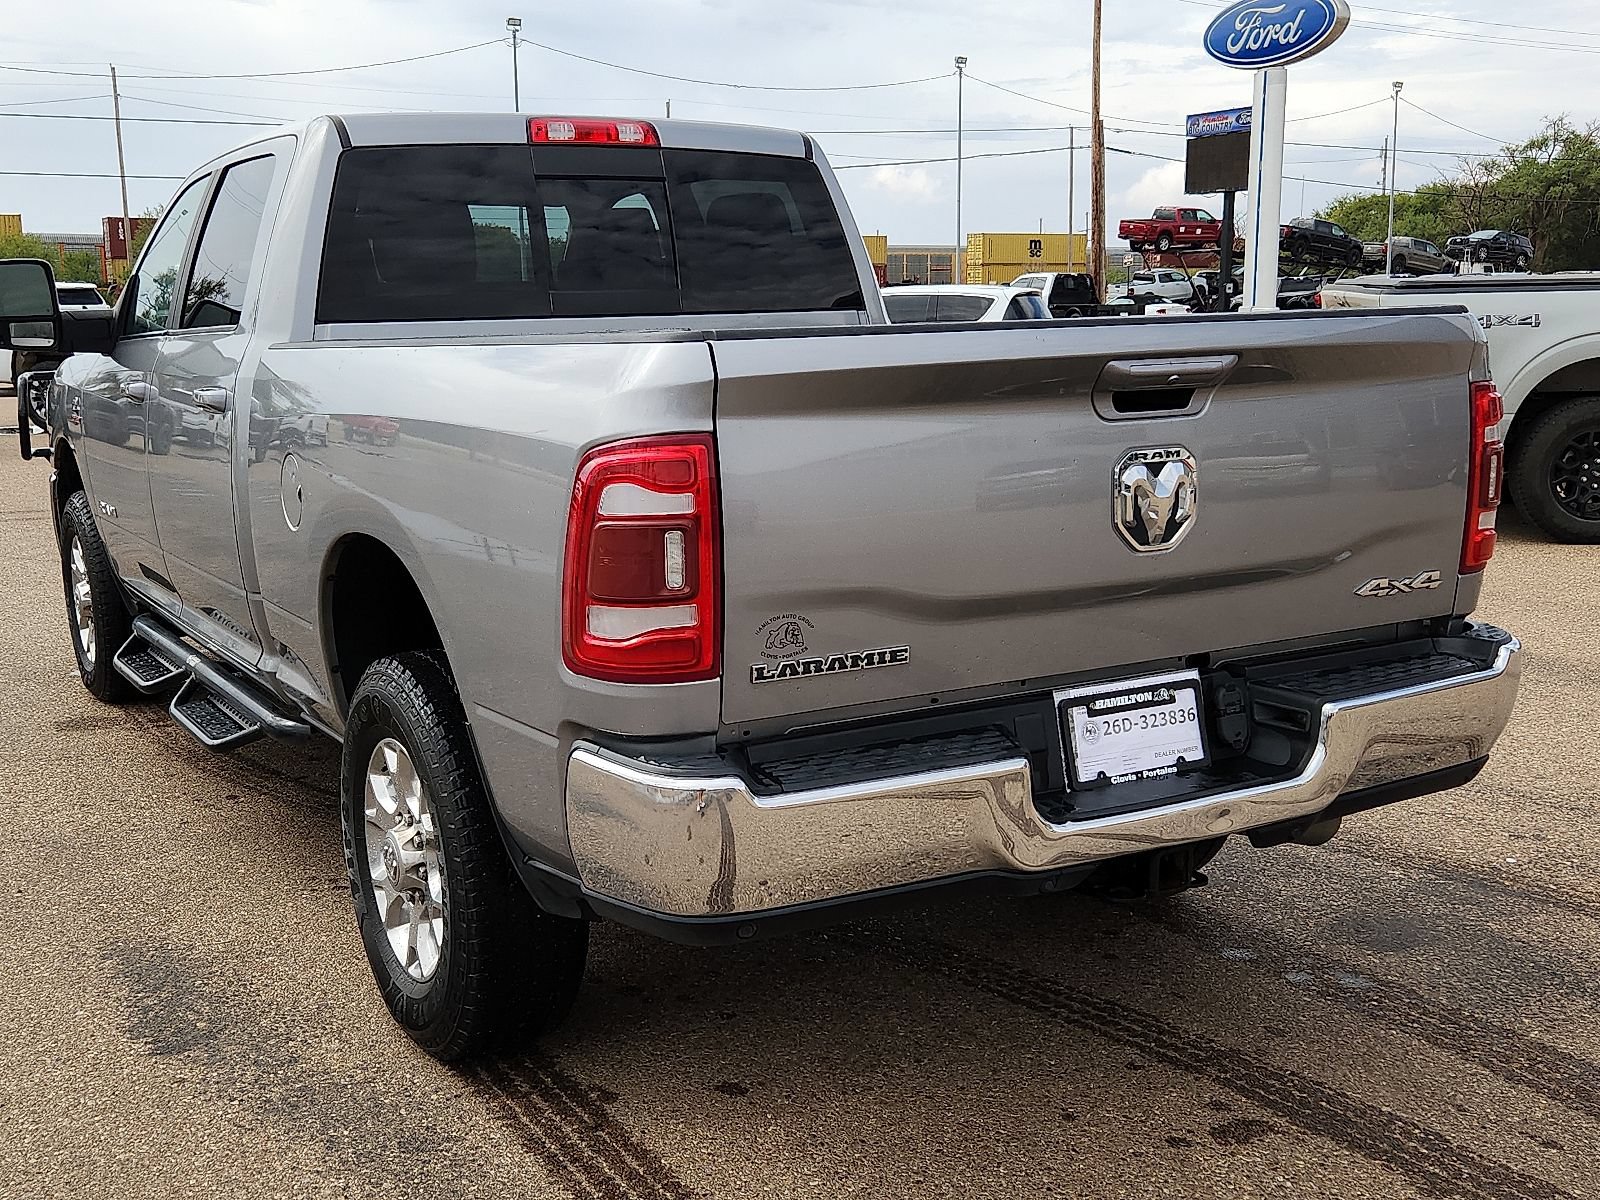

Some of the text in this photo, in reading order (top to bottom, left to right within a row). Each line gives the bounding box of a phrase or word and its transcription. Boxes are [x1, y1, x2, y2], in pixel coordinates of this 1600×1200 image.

[1226, 4, 1306, 54] Ford
[1188, 121, 1234, 135] BIG COUNTRY
[1134, 449, 1181, 460] RAM
[755, 615, 781, 636] HAMILTON
[797, 615, 815, 629] GROUP
[781, 646, 809, 660] PORTALES
[750, 645, 911, 684] LARAMIE
[1095, 691, 1153, 710] HAMILTON
[1102, 707, 1196, 737] 26D-323836
[1154, 745, 1199, 758] DEALER NUMBER
[1110, 765, 1178, 785] Clovis Portales
